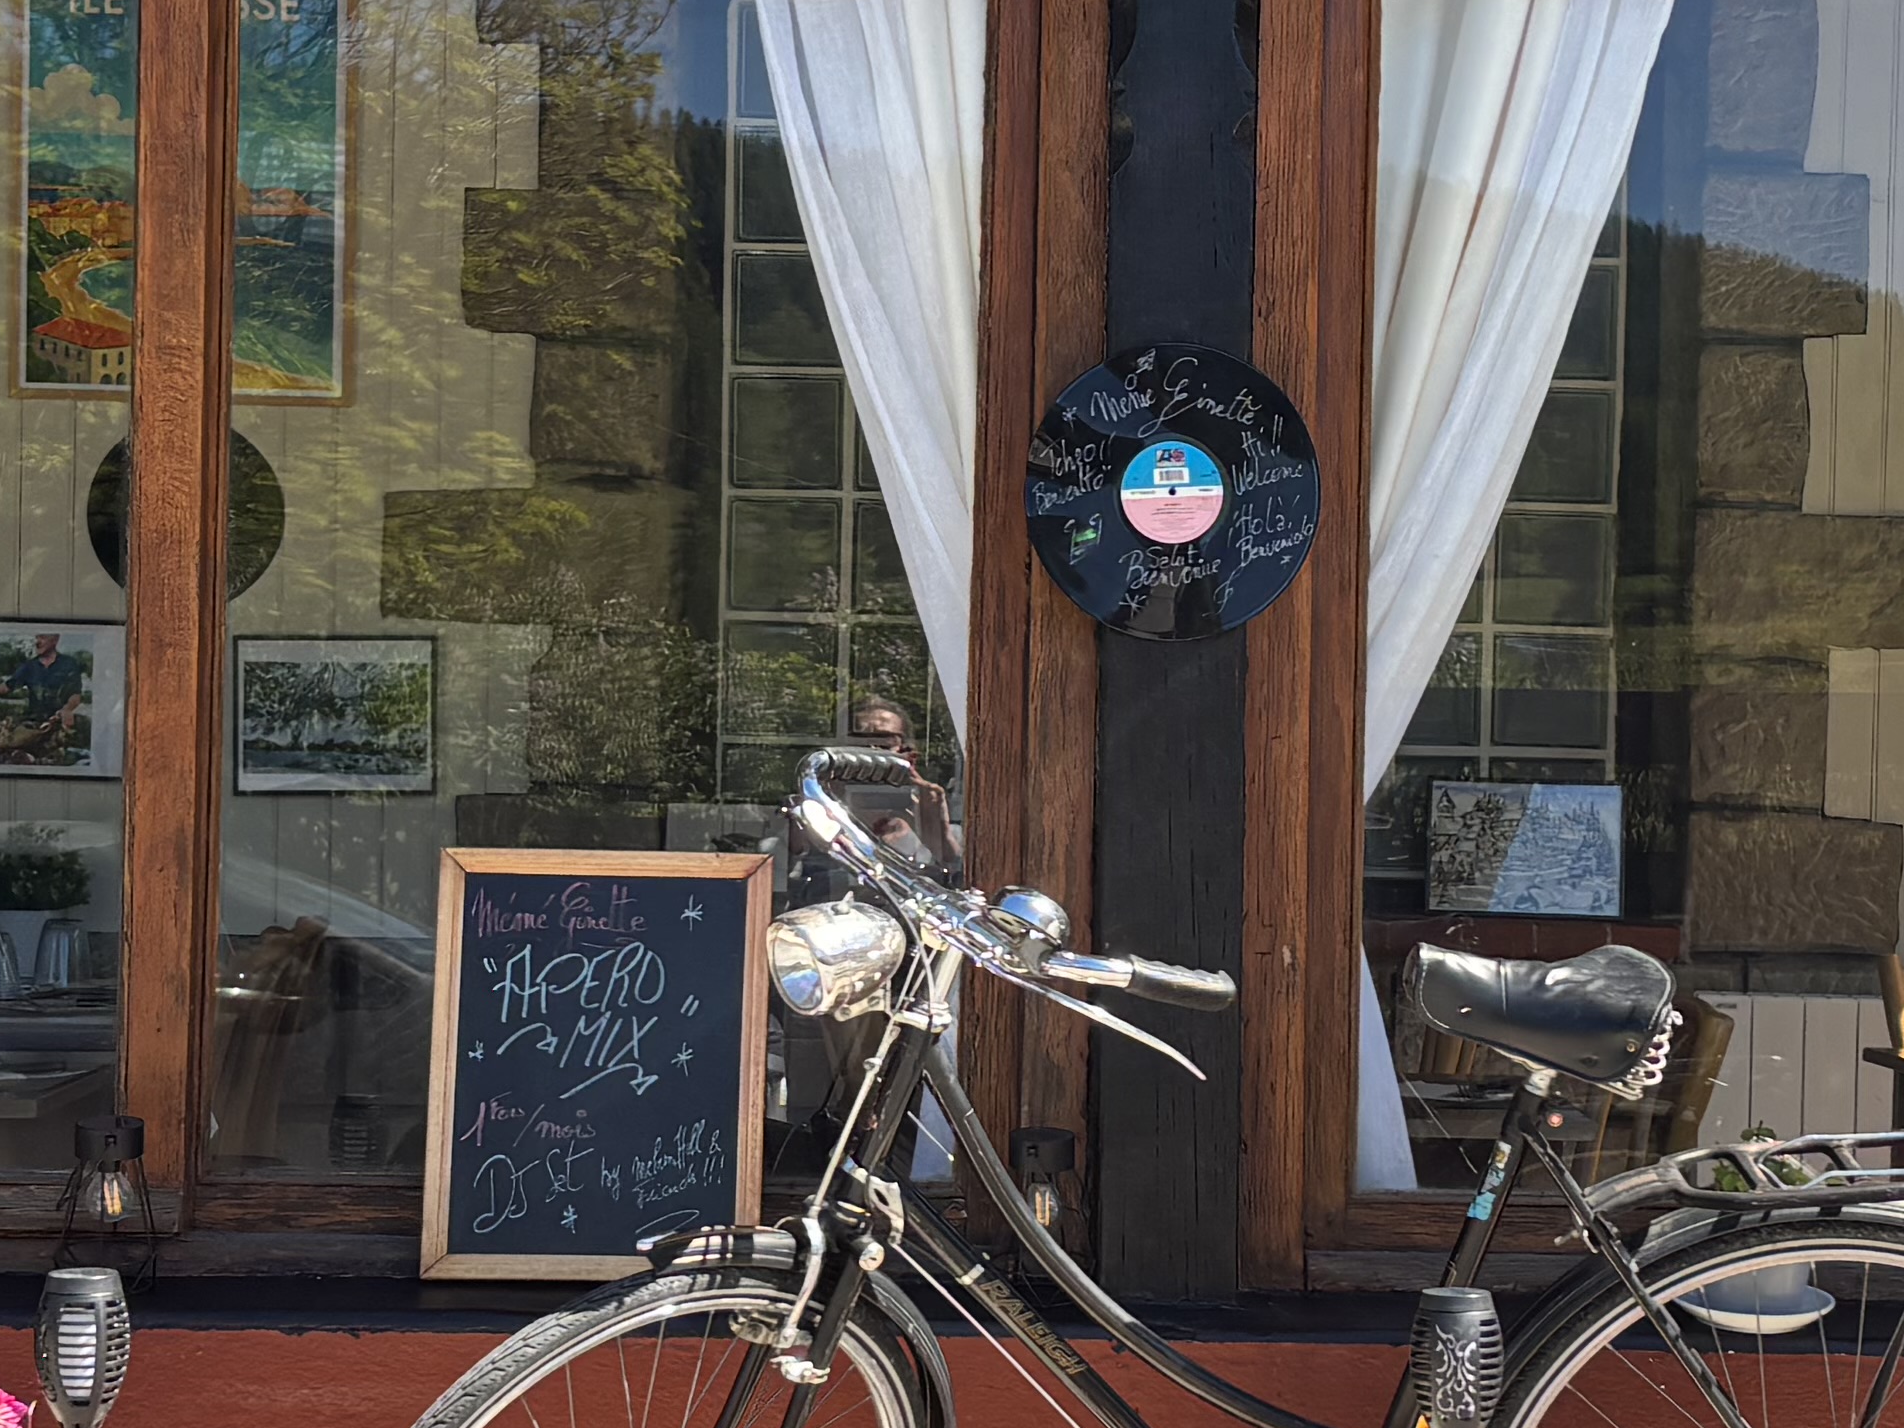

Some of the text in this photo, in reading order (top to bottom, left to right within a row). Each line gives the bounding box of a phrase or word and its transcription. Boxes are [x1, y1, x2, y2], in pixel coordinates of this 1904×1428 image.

[1231, 456, 1305, 496] Welcome
[559, 1010, 659, 1069] MIX
[545, 1137, 595, 1204] Set
[599, 1155, 622, 1202] by
[978, 1278, 1089, 1376] RALEIGH
